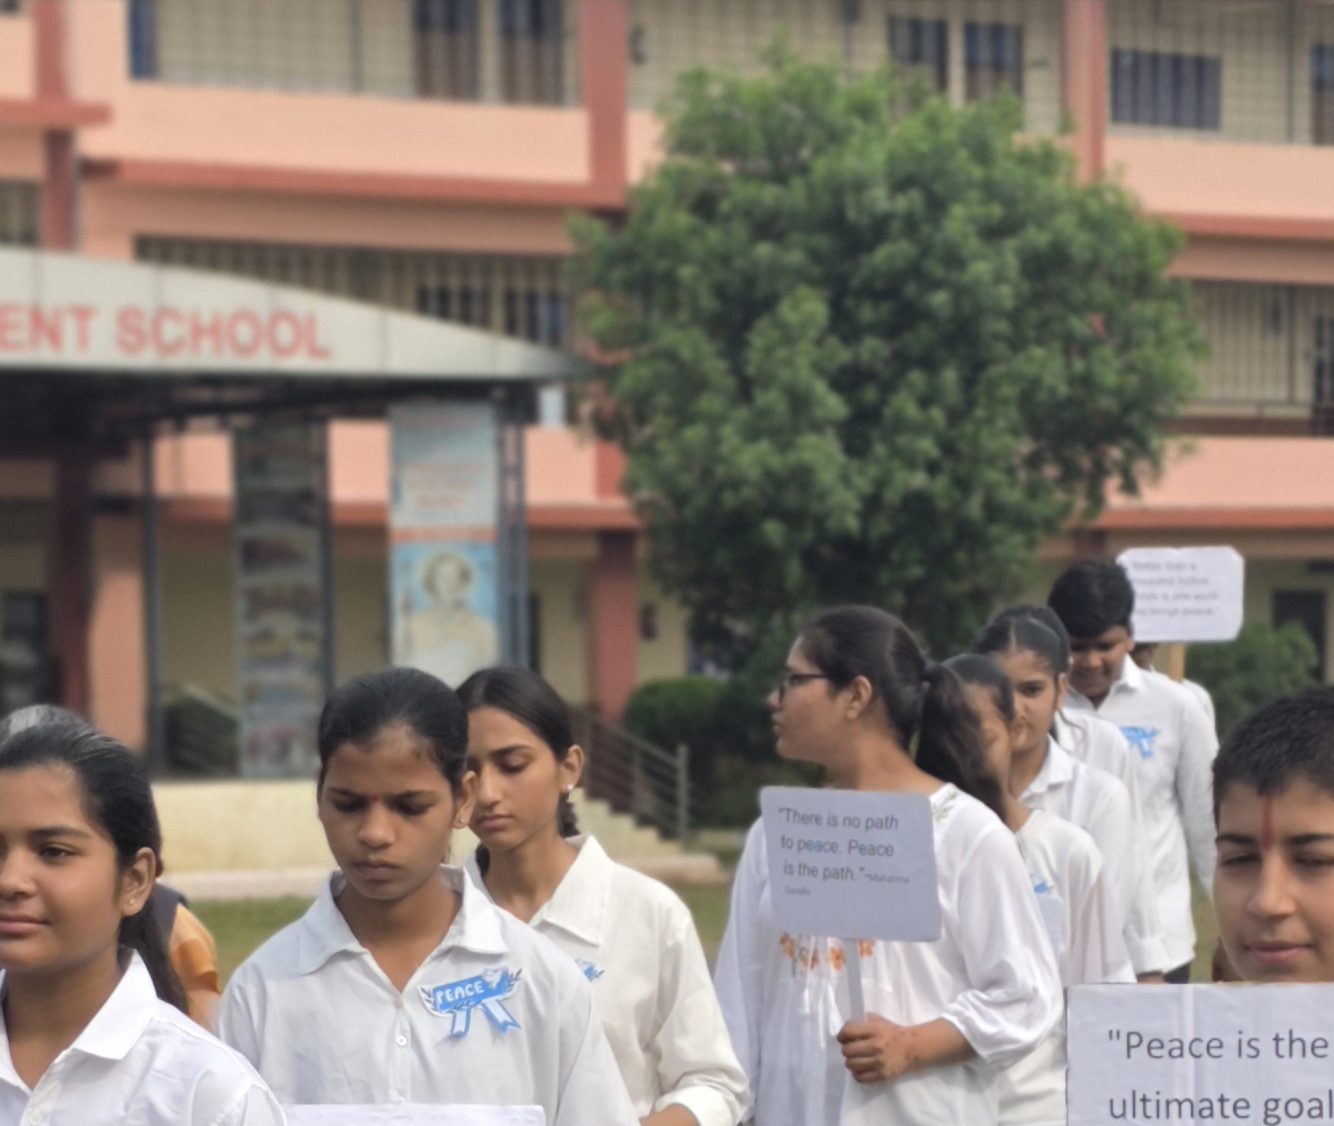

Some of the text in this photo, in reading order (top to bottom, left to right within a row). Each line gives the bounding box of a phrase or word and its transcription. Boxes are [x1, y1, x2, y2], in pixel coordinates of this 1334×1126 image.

[115, 307, 329, 360] SCHOOL
[827, 811, 839, 827] is
[842, 816, 861, 828] no
[865, 815, 899, 833] path
[781, 835, 894, 857] to peace. Peace
[783, 859, 794, 875] is
[798, 862, 819, 878] the
[435, 980, 485, 1004] PEACE
[1237, 1030, 1261, 1060] is
[1273, 1029, 1329, 1060] the
[1109, 1090, 1251, 1121] ultimate
[1262, 1090, 1334, 1126] goal
